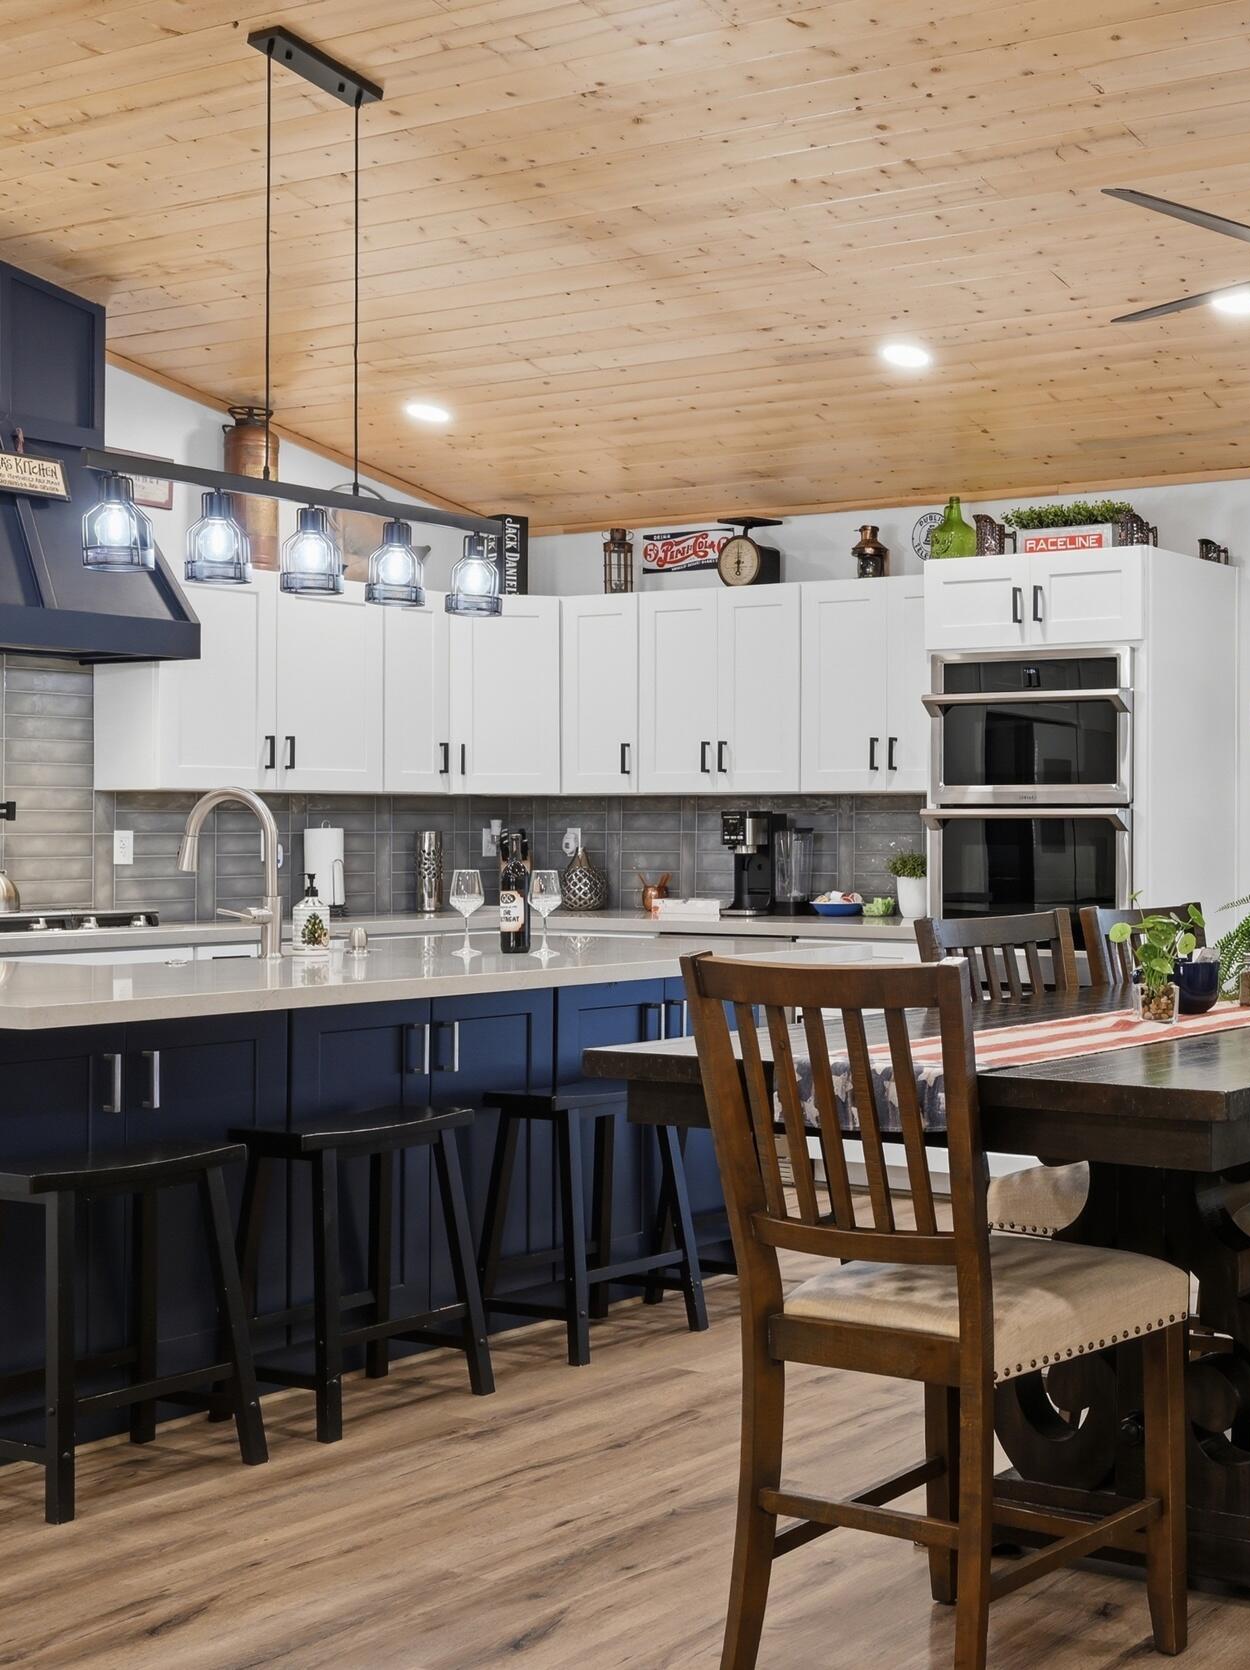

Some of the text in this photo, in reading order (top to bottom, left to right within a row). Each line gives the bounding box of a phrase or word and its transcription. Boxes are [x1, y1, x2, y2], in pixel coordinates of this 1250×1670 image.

[0, 457, 58, 480] A'S KITCHEN
[1026, 535, 1099, 552] RACELINE
[505, 518, 520, 595] JACK DANIEL'
